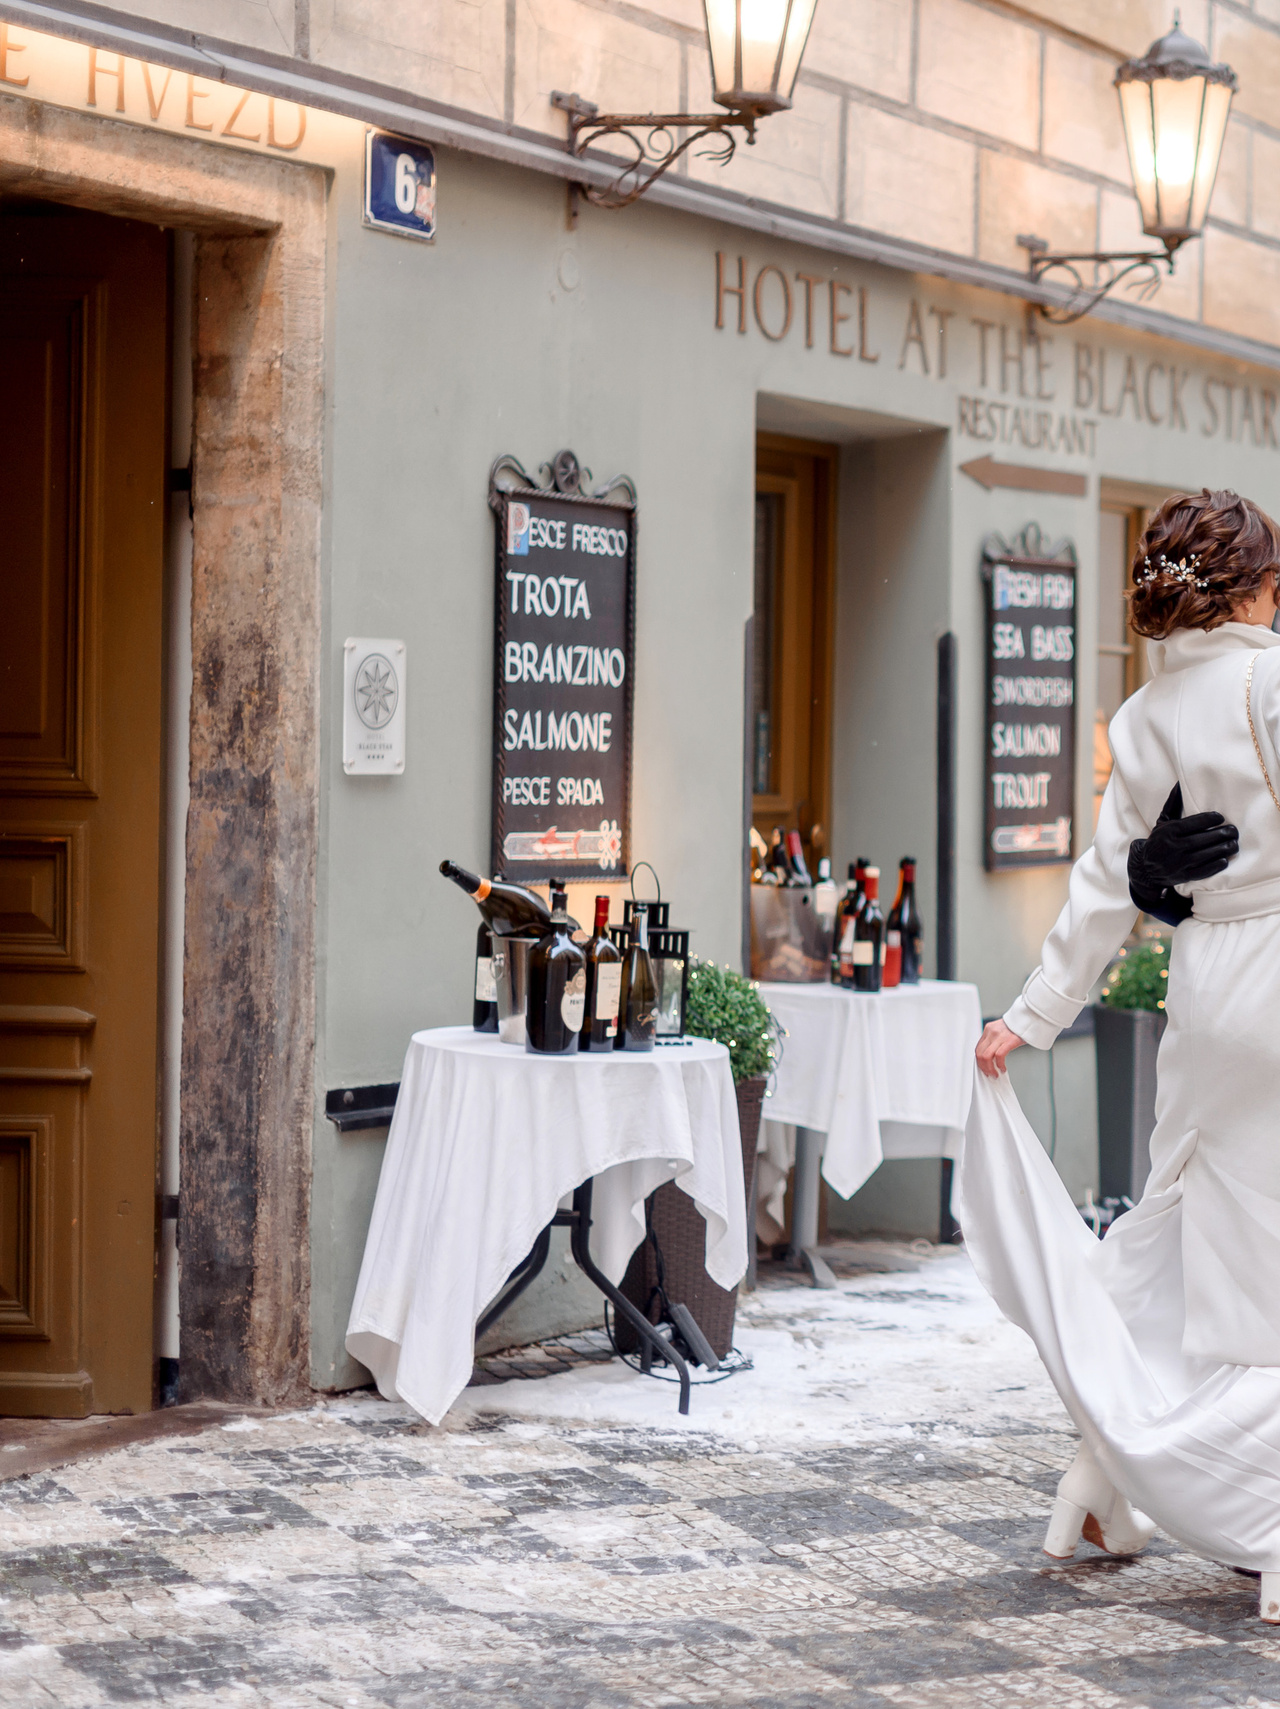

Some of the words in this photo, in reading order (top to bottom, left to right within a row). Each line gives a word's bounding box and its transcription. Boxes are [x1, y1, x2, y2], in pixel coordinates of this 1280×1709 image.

[395, 153, 417, 214] 6
[714, 251, 880, 364] HOTEL
[898, 296, 955, 379] AT
[970, 318, 1055, 400] THE
[1074, 340, 1189, 432] BLACK
[1201, 376, 1280, 452] STAR
[957, 394, 1098, 457] RESTAURANT
[507, 501, 567, 556] PESCE
[571, 523, 628, 558] FRESCO
[506, 569, 592, 621] TROTA
[993, 563, 1042, 611] FRESH
[1043, 573, 1075, 610] FISH
[504, 640, 625, 689] BRANZINO
[992, 621, 1025, 660] SEA
[1030, 624, 1075, 662] BASS
[992, 675, 1074, 708] SWORDFISH
[503, 708, 613, 753] SALMONE
[992, 721, 1062, 758] SALMON
[503, 776, 551, 806] PESCE
[557, 776, 605, 806] SPADA
[991, 771, 1052, 809] TROUT
